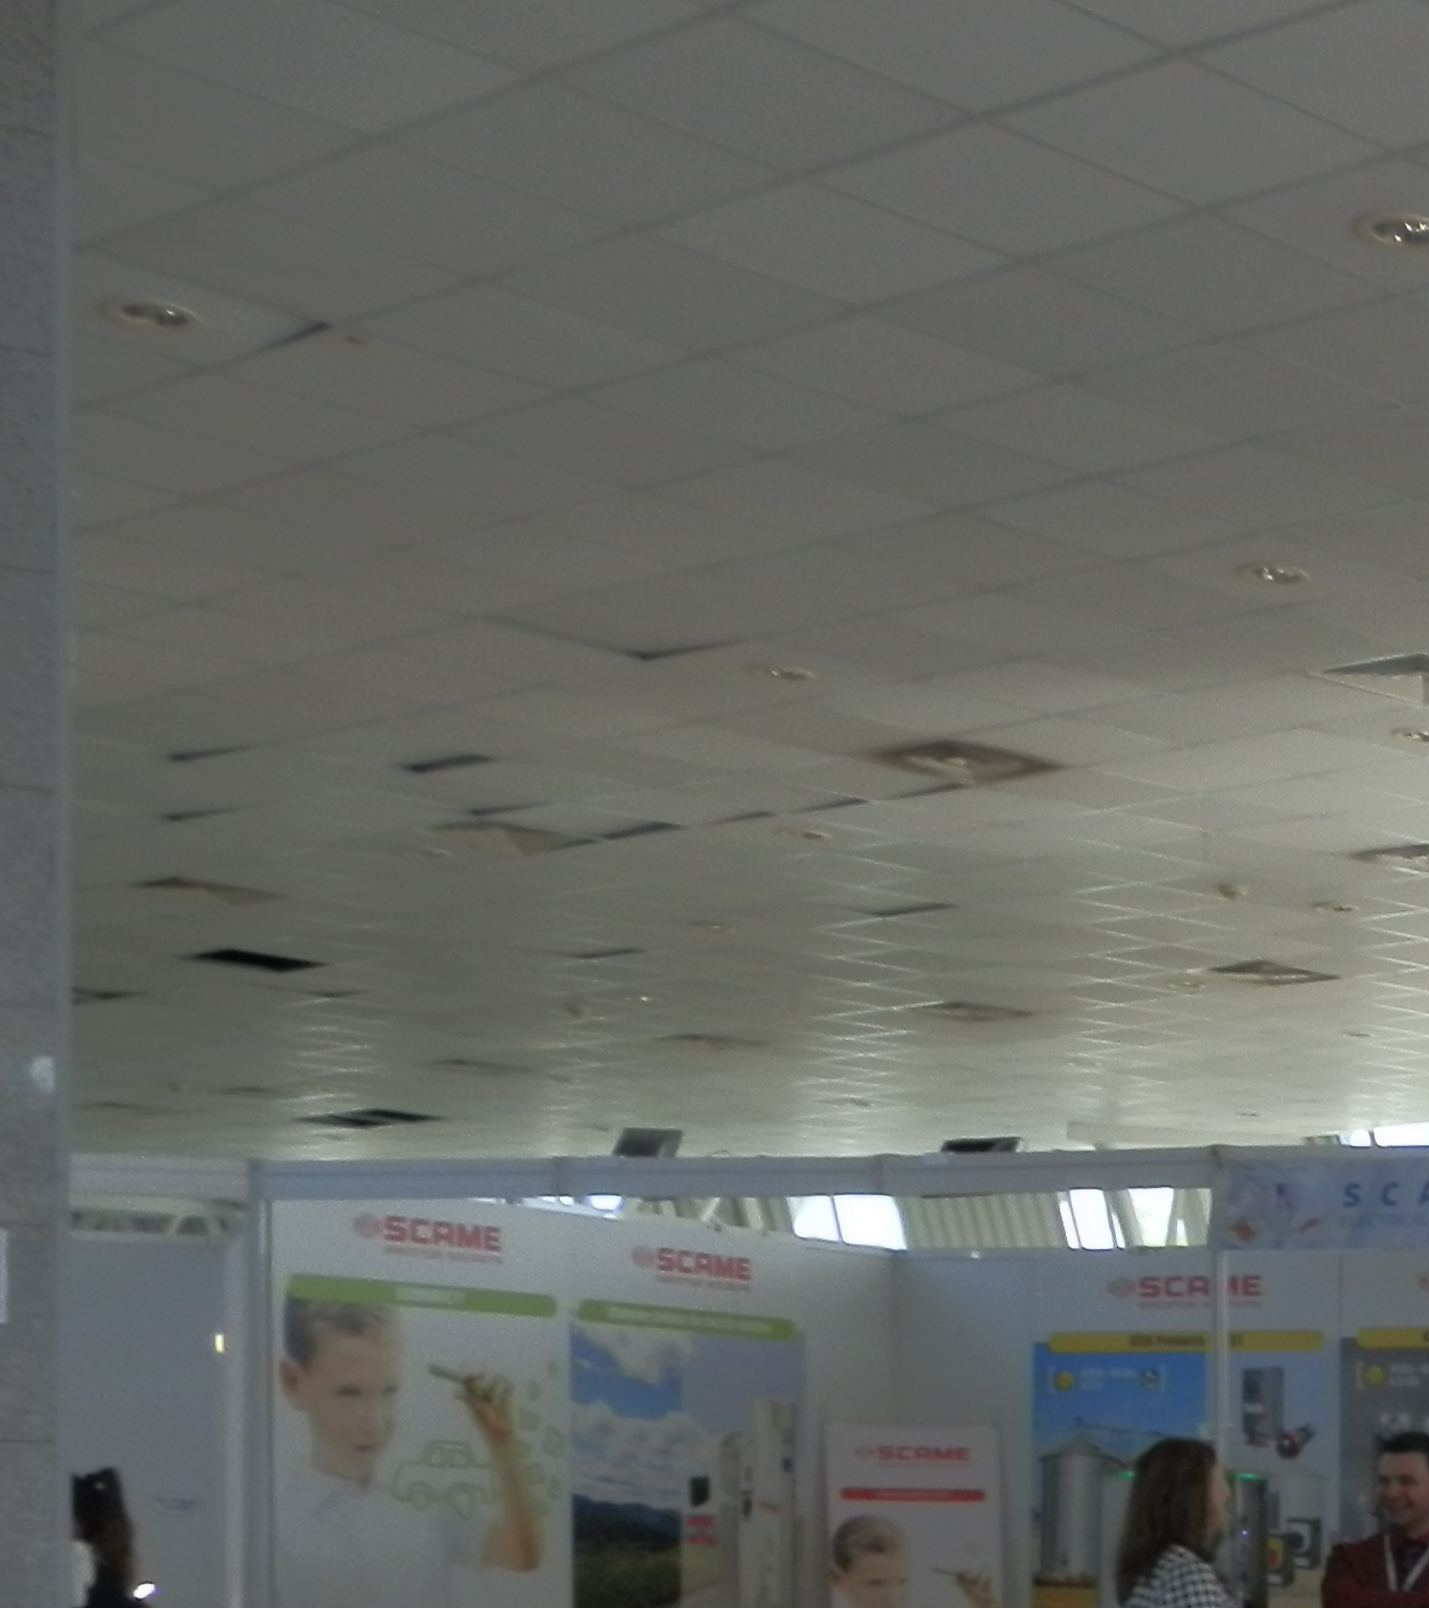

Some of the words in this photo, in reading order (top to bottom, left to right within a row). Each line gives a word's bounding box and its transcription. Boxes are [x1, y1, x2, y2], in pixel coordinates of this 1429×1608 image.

[1340, 1209, 1429, 1229] ELECTRICAL
[384, 1215, 503, 1252] SCAME
[656, 1247, 752, 1282] SCAME
[876, 1445, 971, 1462] SCAME
